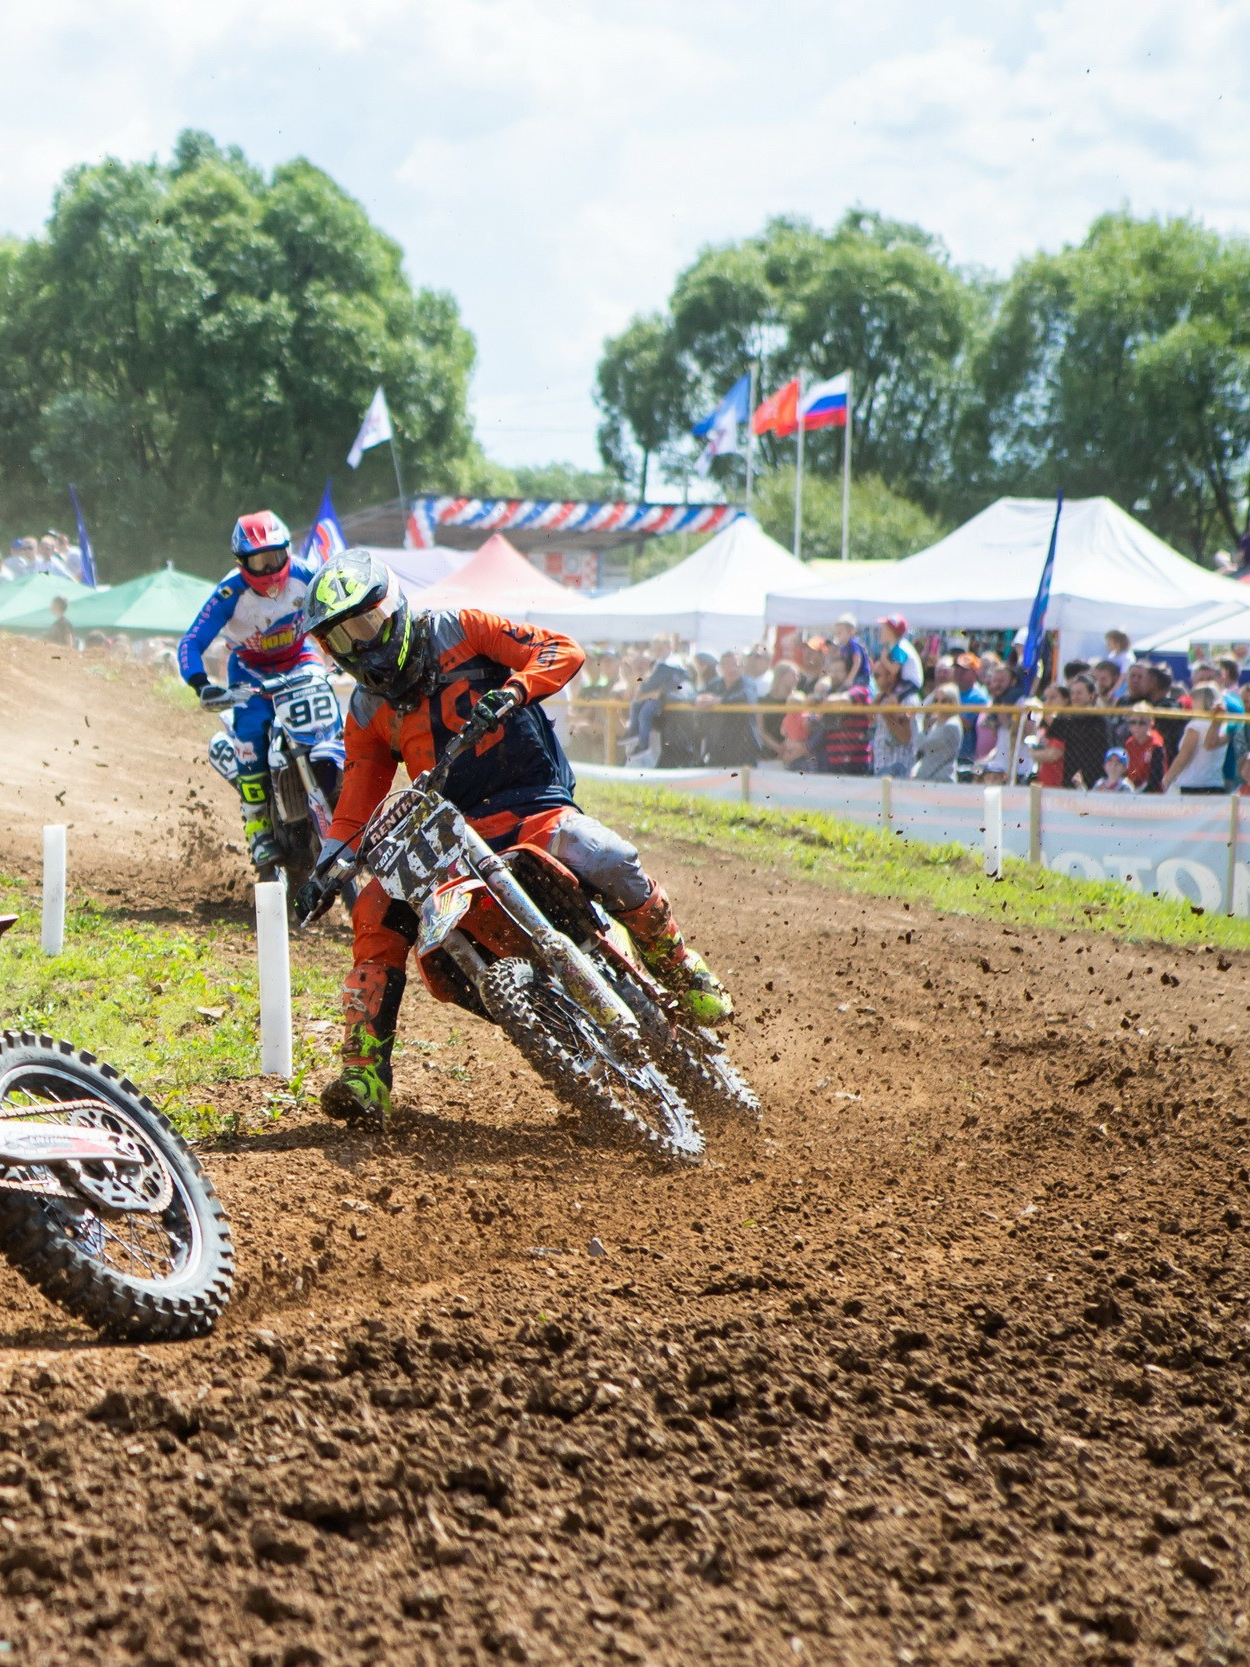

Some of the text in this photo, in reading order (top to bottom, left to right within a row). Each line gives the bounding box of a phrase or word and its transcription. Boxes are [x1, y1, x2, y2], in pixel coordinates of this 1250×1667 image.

[289, 695, 334, 729] 92
[210, 739, 237, 774] 92
[370, 783, 425, 846] RENTHA
